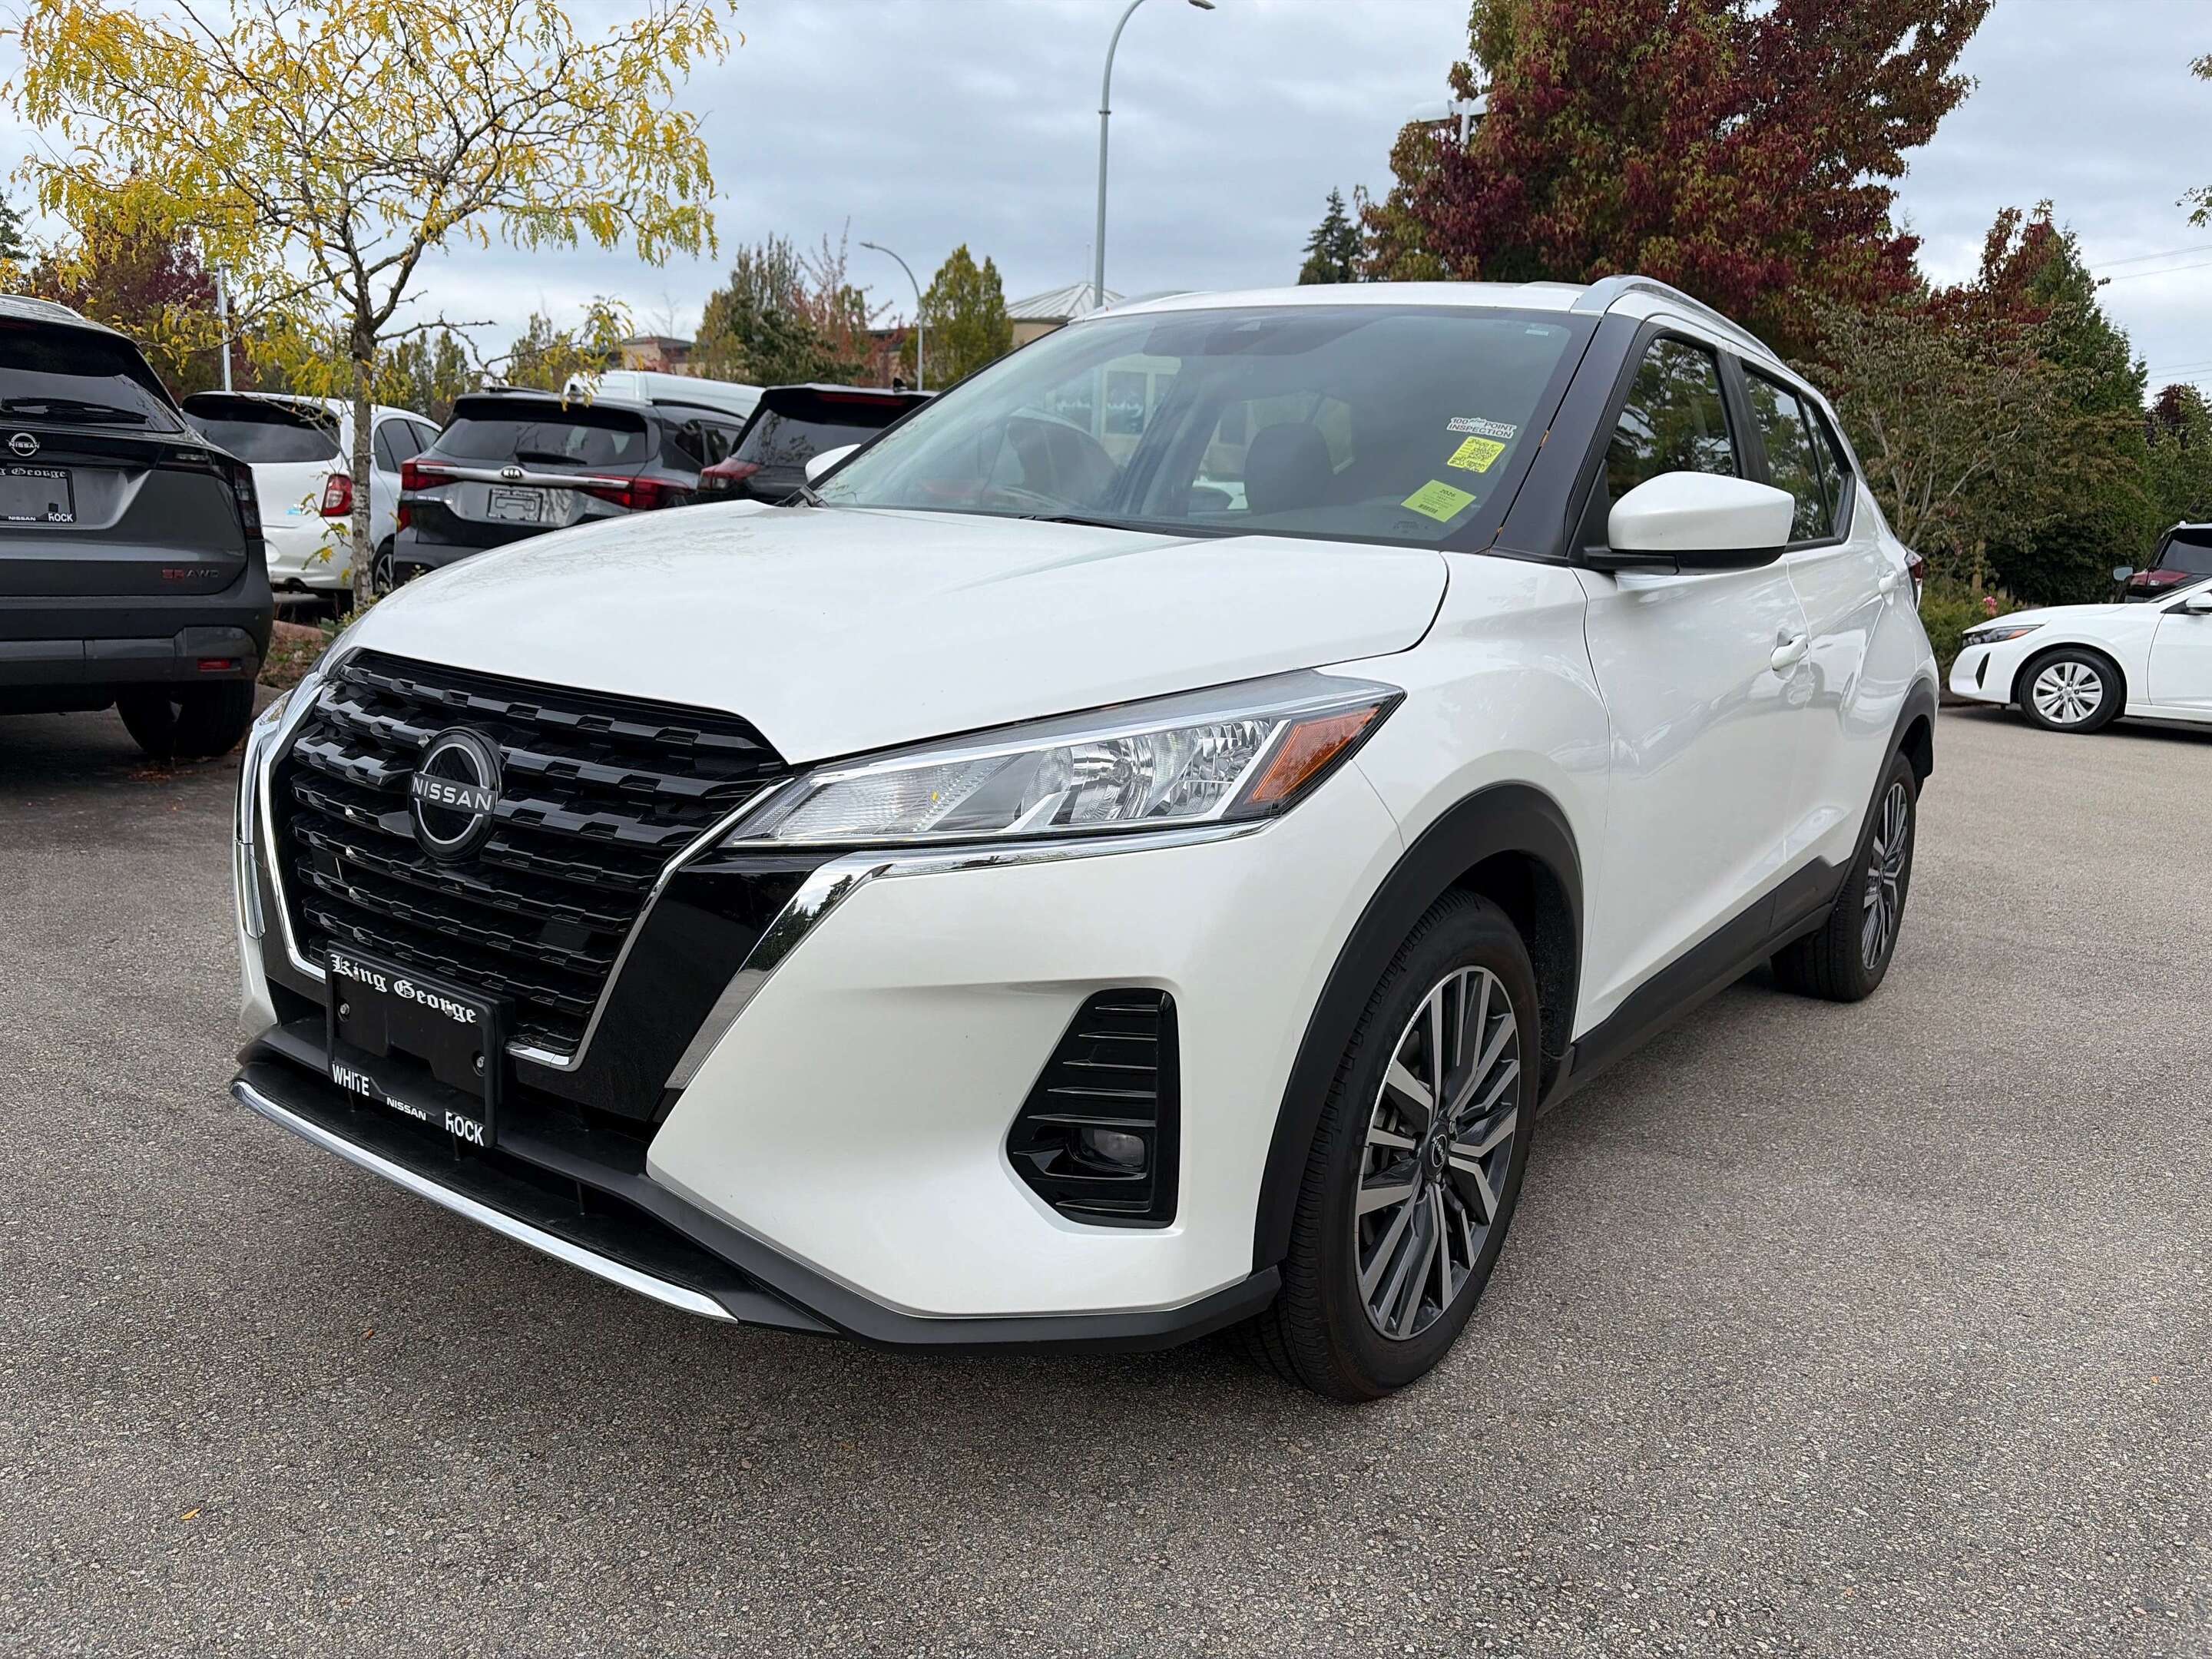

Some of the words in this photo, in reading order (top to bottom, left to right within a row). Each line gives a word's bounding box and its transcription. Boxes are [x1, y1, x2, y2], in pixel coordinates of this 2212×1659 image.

[1449, 423, 1512, 437] INSPECTION
[1484, 421, 1514, 430] POINT
[8, 441, 40, 449] NISSAN
[11, 467, 66, 478] George
[48, 512, 74, 522] ROCK
[187, 568, 220, 578] AWD
[412, 777, 492, 811] NISSAN
[330, 952, 388, 993] King
[393, 979, 477, 1024] George
[332, 1063, 370, 1097] WHITE
[386, 1097, 427, 1121] NISSAN
[445, 1111, 485, 1147] ROCK
